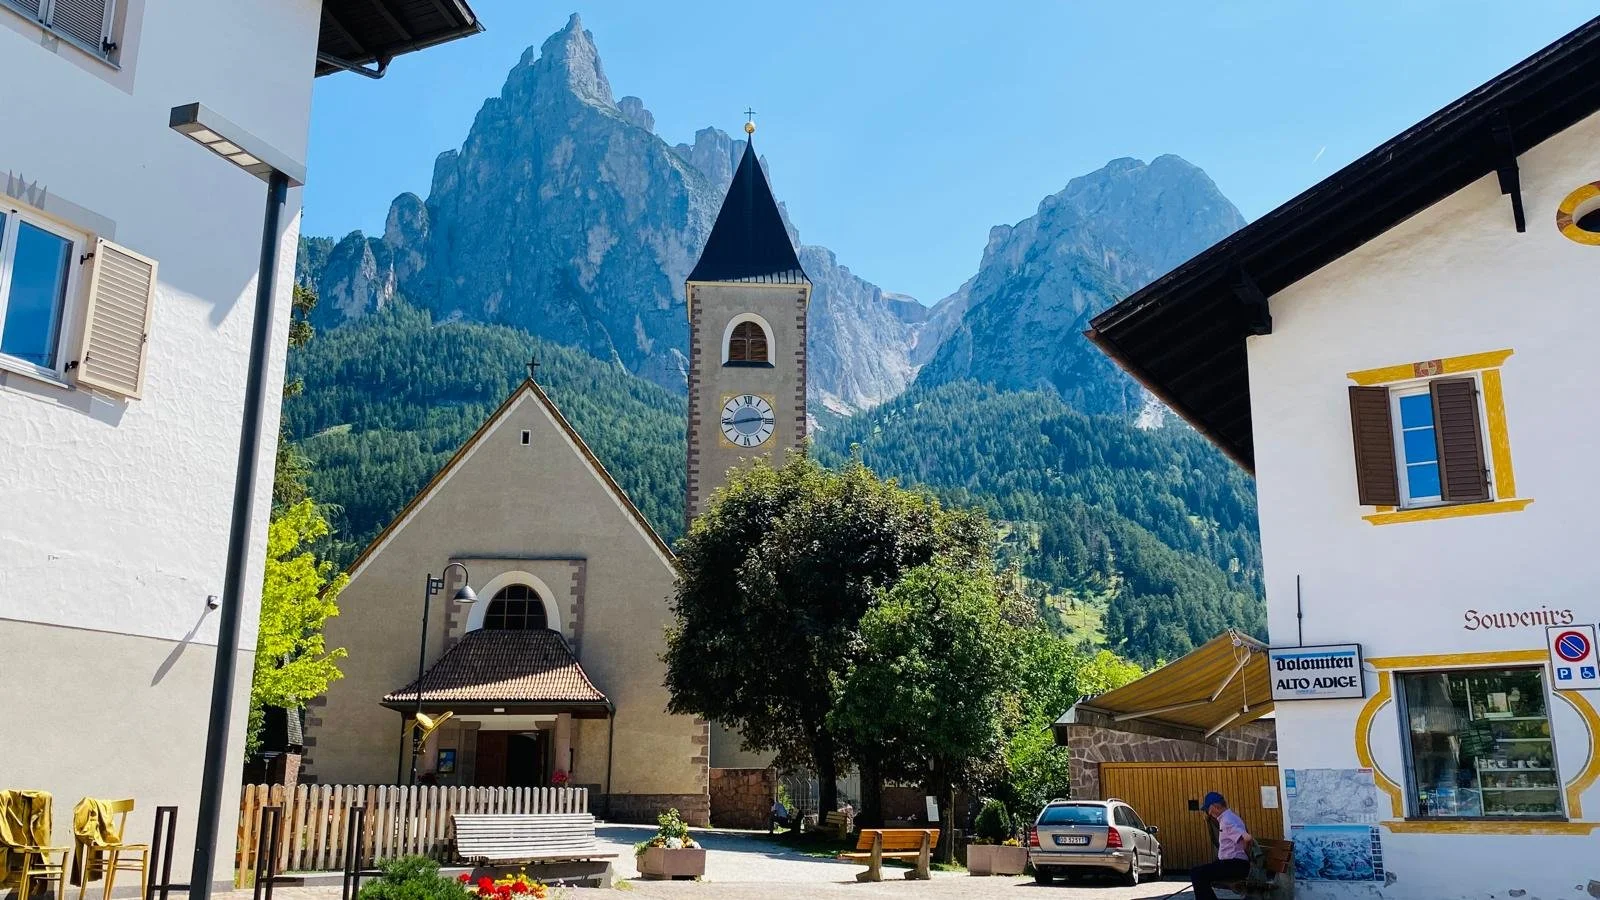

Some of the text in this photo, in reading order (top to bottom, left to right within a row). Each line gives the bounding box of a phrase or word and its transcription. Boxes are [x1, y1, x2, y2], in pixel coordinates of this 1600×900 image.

[1463, 605, 1574, 631] Souvenirs
[1275, 655, 1354, 672] Dolomiten
[1560, 670, 1569, 679] P
[1276, 675, 1358, 691] ALTO ADIGE
